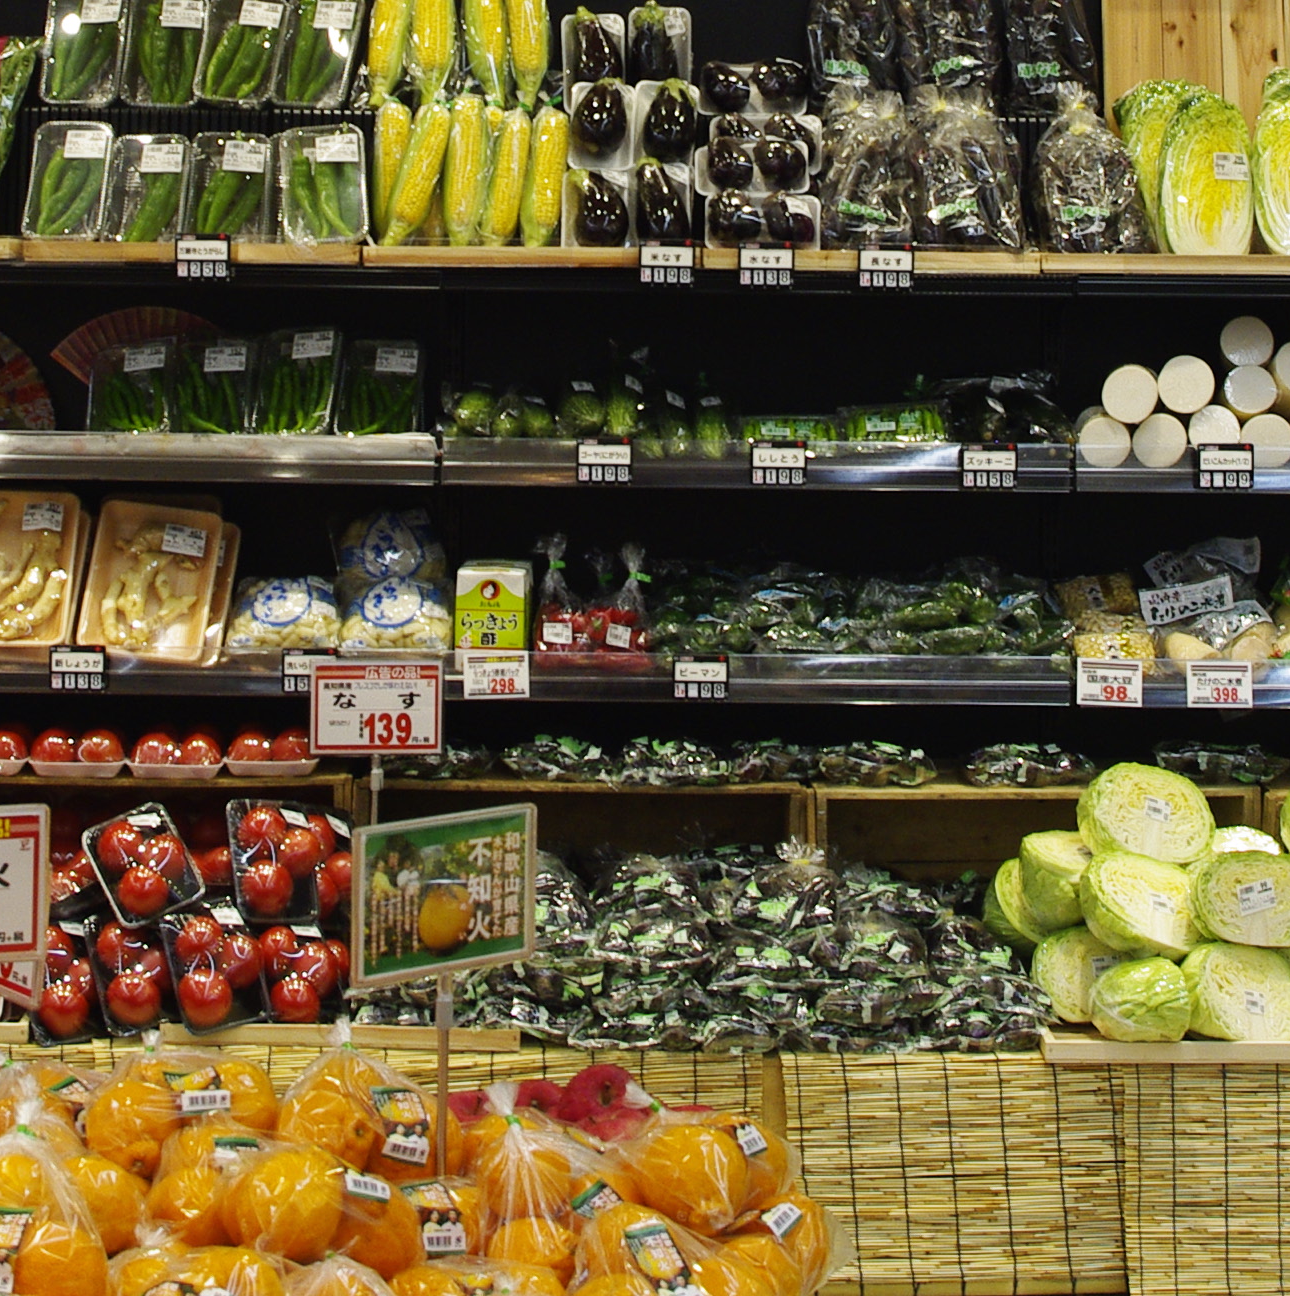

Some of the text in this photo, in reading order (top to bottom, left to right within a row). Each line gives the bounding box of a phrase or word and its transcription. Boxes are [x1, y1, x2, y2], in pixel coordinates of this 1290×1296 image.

[759, 454, 799, 463] ししとう
[966, 456, 1013, 466] ズッキーニ
[460, 612, 518, 631] らっきょう
[55, 658, 101, 668] 新しょうが
[364, 666, 421, 680] 広告の品!
[679, 668, 720, 677] ピーマン
[1087, 674, 1133, 685] 国産大豆
[490, 678, 515, 693] 298
[1103, 685, 1127, 701] 98
[333, 692, 422, 710] なす
[1213, 687, 1238, 702] 398
[363, 713, 412, 745] 139
[467, 836, 492, 942] 不知火
